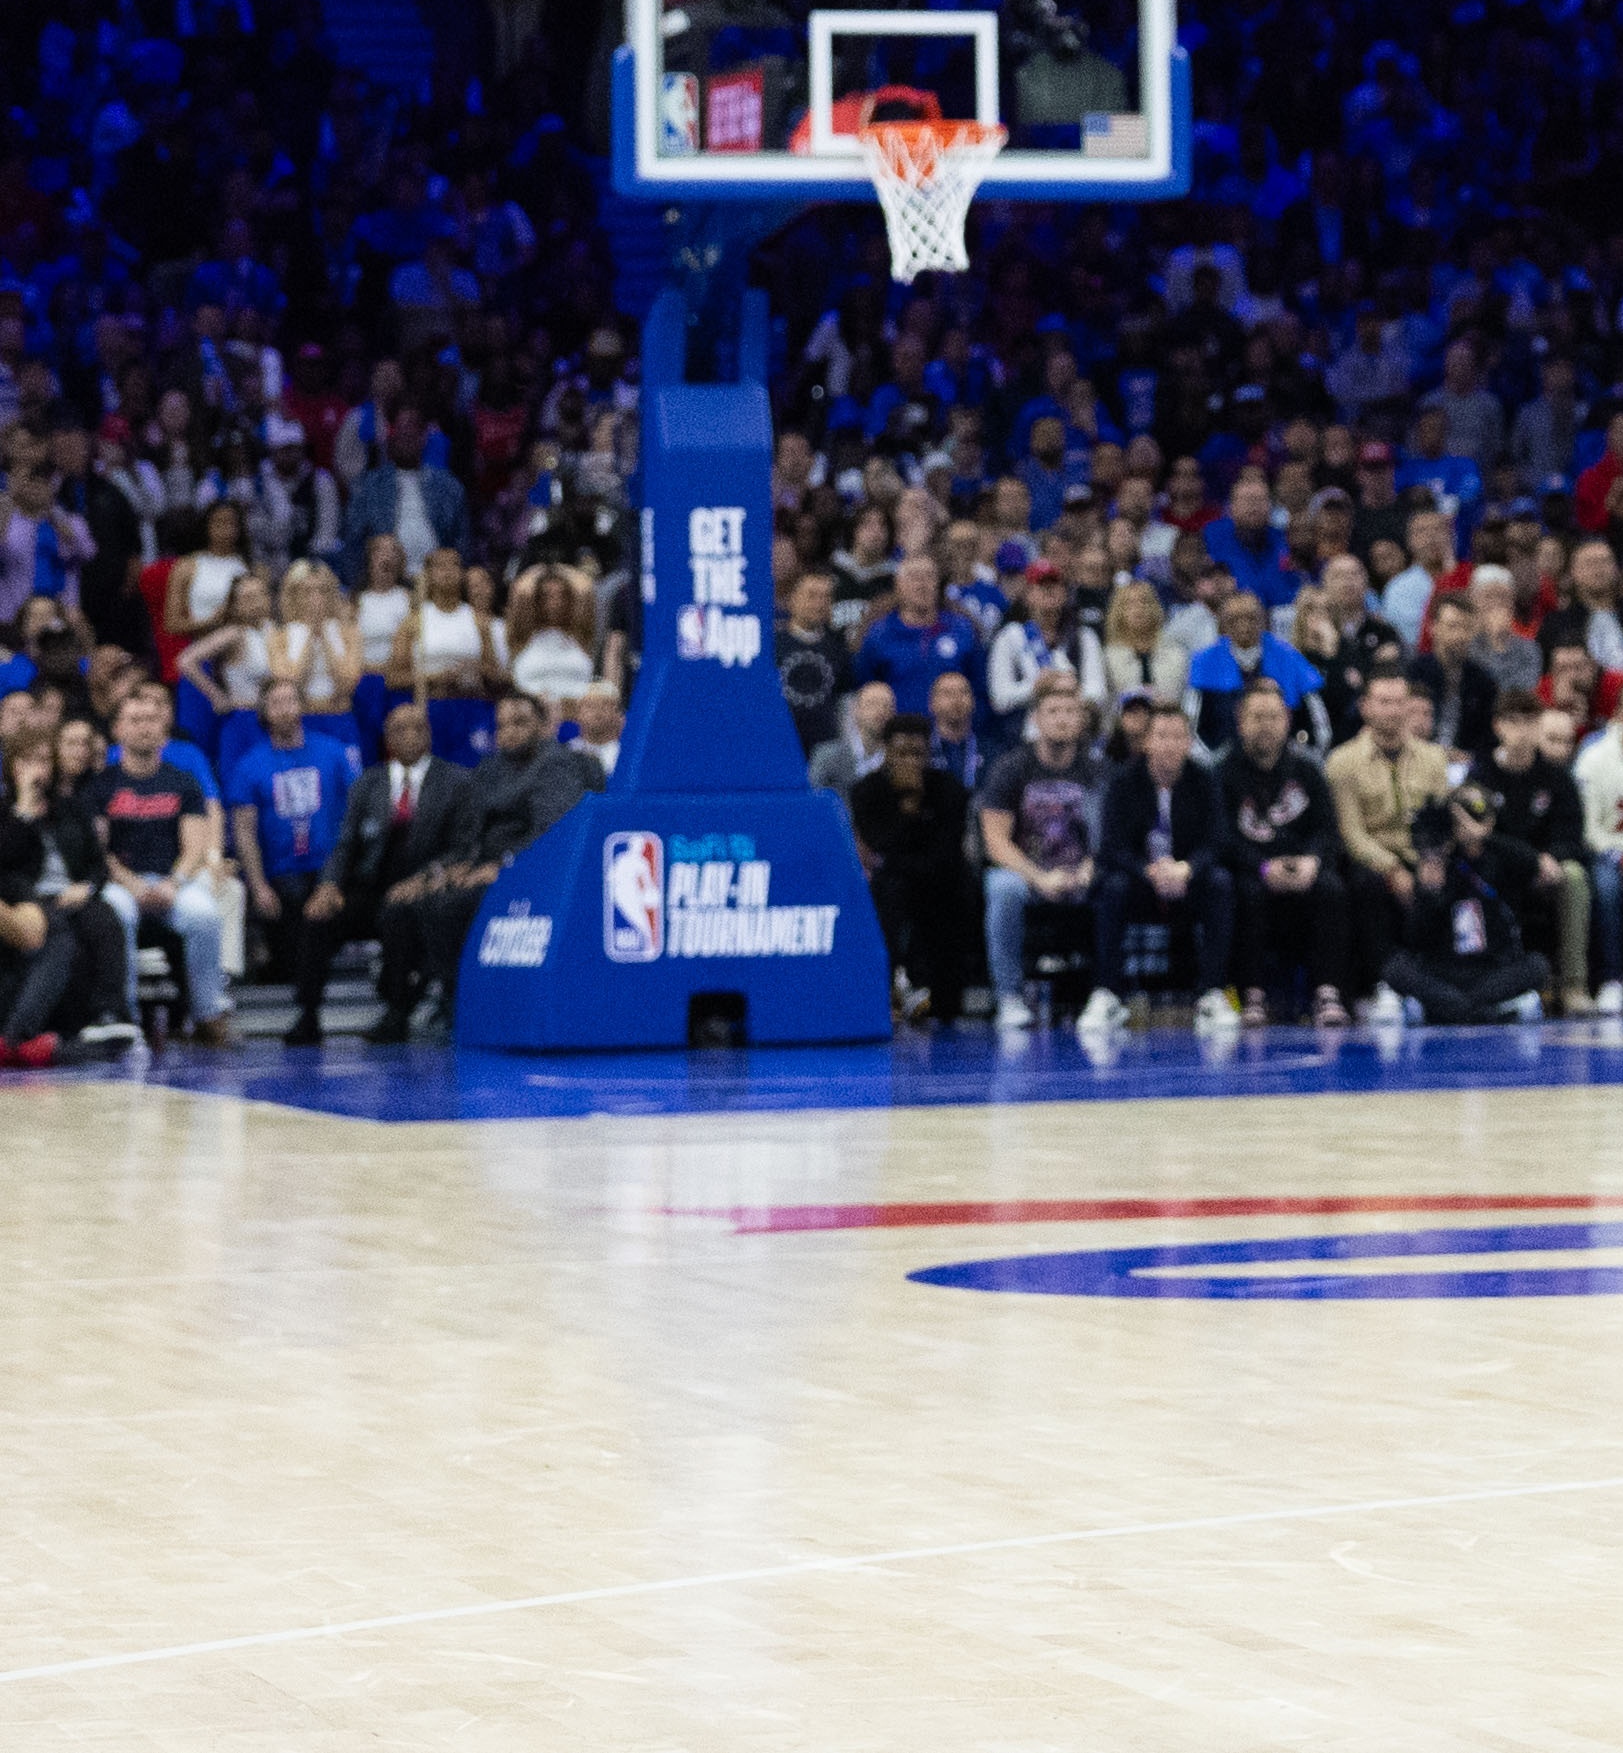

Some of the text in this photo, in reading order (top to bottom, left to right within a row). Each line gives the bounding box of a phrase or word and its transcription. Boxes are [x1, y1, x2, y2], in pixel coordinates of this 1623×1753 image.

[688, 506, 747, 555] GET
[689, 556, 749, 607] THE
[668, 860, 772, 908] PLAY-IN
[666, 905, 840, 959] TOURNAMENT
